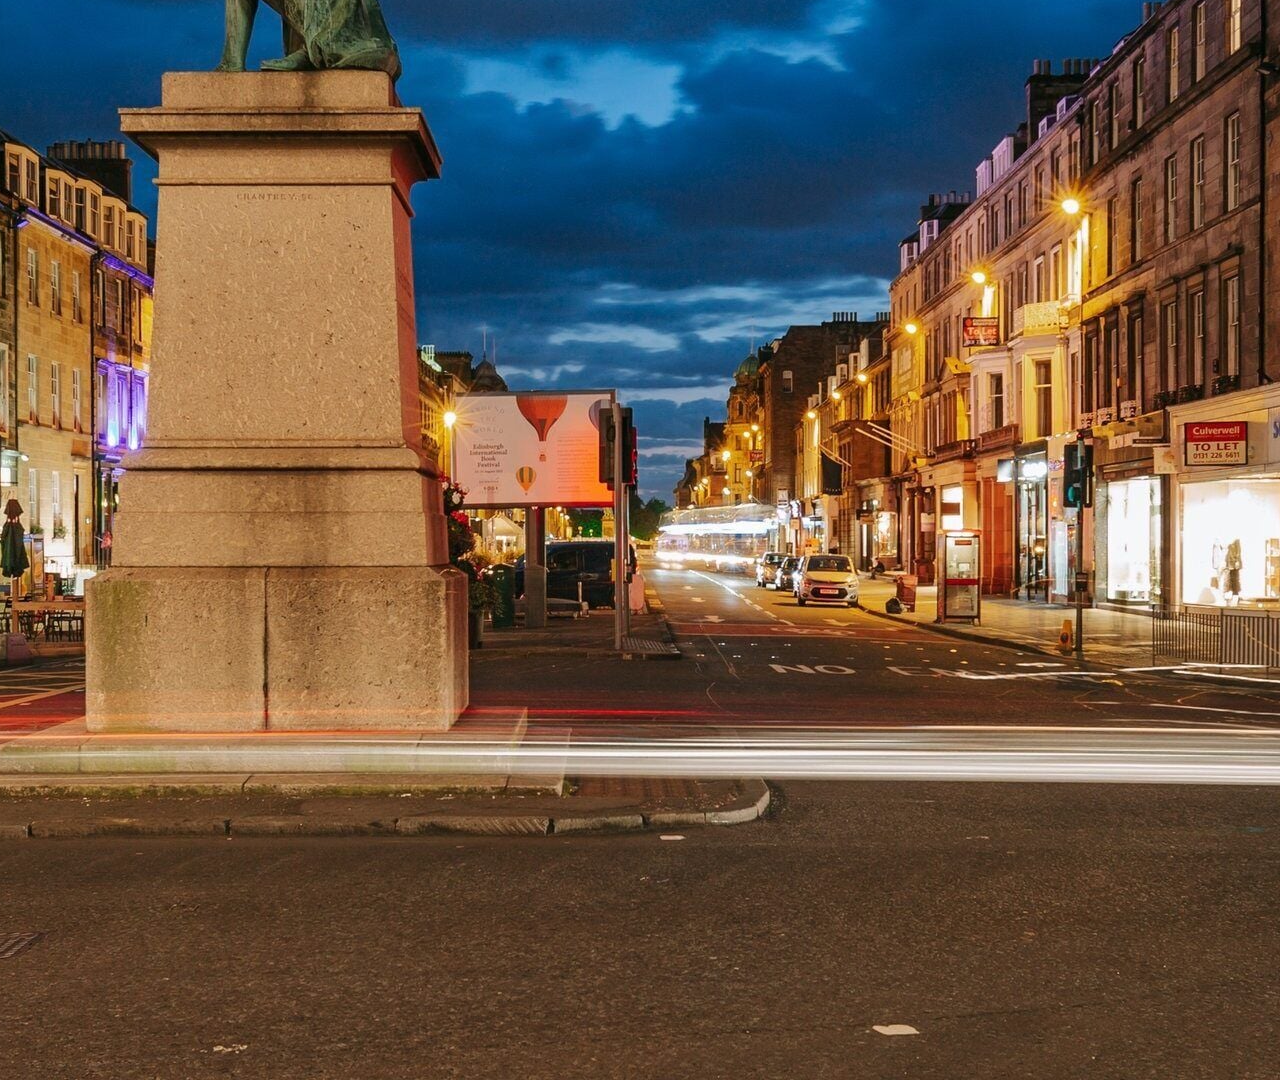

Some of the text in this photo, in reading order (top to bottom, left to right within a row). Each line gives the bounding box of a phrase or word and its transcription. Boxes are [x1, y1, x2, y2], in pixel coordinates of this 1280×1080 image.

[967, 326, 997, 336] To Let
[1192, 425, 1240, 435] Culverwell
[473, 443, 504, 451] Edinburgh
[1193, 442, 1239, 452] TO LET
[1193, 452, 1208, 460] 0131
[769, 664, 857, 675] NO
